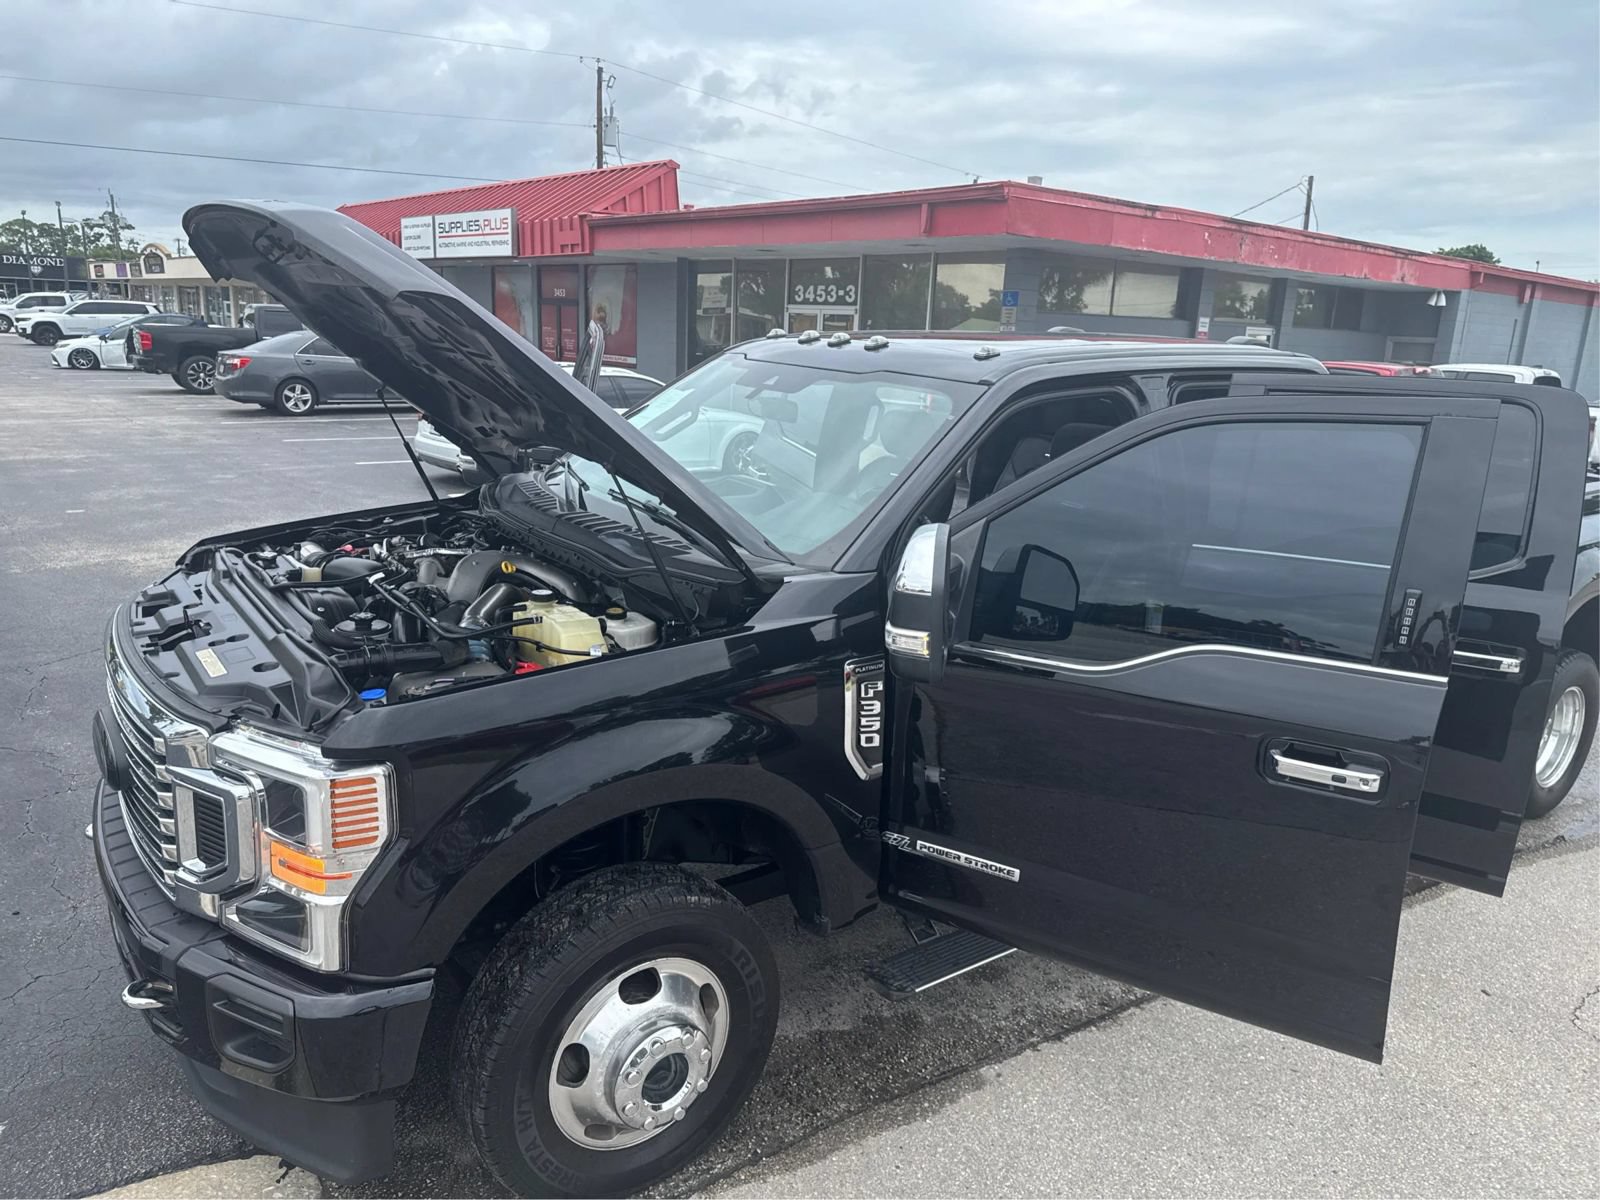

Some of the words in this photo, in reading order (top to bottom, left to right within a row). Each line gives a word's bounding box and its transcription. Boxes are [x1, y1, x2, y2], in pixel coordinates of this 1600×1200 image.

[438, 219, 480, 234] SUPPLIES
[483, 217, 509, 231] PLUS
[2, 254, 65, 267] DIAMOND
[553, 287, 566, 297] 3453
[794, 284, 856, 303] 3453-3
[855, 663, 884, 674] PLATINUM
[860, 680, 884, 748] F350
[918, 842, 962, 863] POWER
[964, 856, 1016, 878] STROKE
